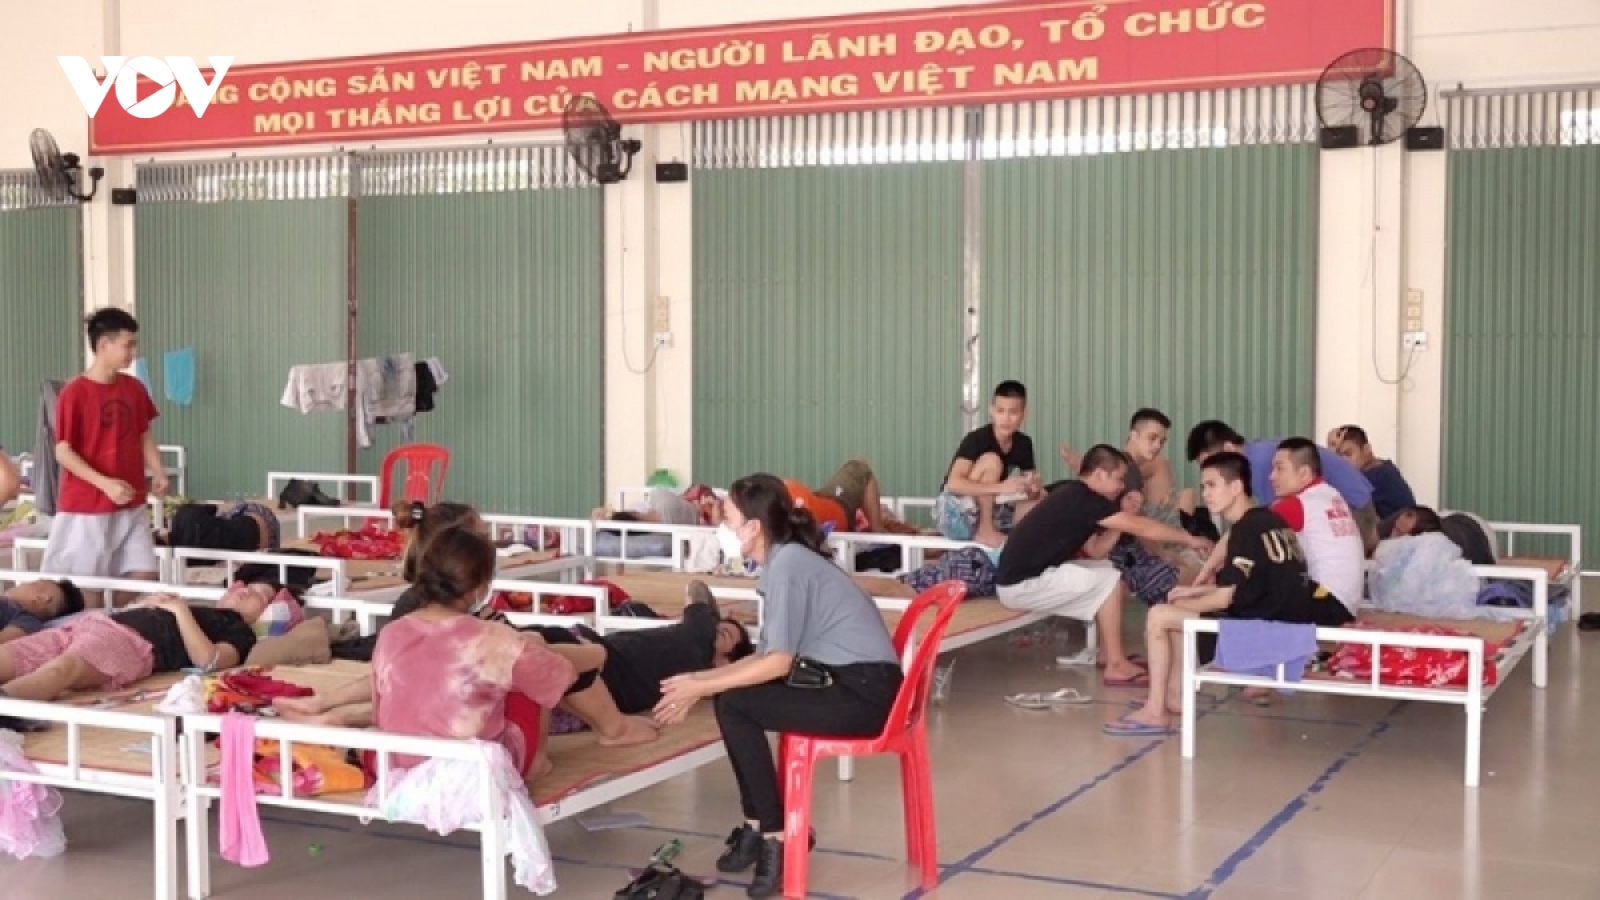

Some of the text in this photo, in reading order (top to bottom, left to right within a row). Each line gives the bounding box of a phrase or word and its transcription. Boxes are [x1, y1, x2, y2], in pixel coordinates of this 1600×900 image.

[248, 77, 337, 104] CỘNG
[347, 66, 415, 93] SẢN
[427, 61, 507, 90] VIỆT
[521, 56, 603, 82] NAM
[643, 40, 766, 73] NGƯỜI
[782, 33, 897, 62] LÃNH
[913, 24, 1025, 54] ĐẠO,
[1040, 4, 1106, 44] TỔ
[1123, 0, 1266, 37] CHỨC
[254, 57, 1099, 135] MỌI THẮNG LỢI CỦA CÁCH MẠNG VIỆT NAM
